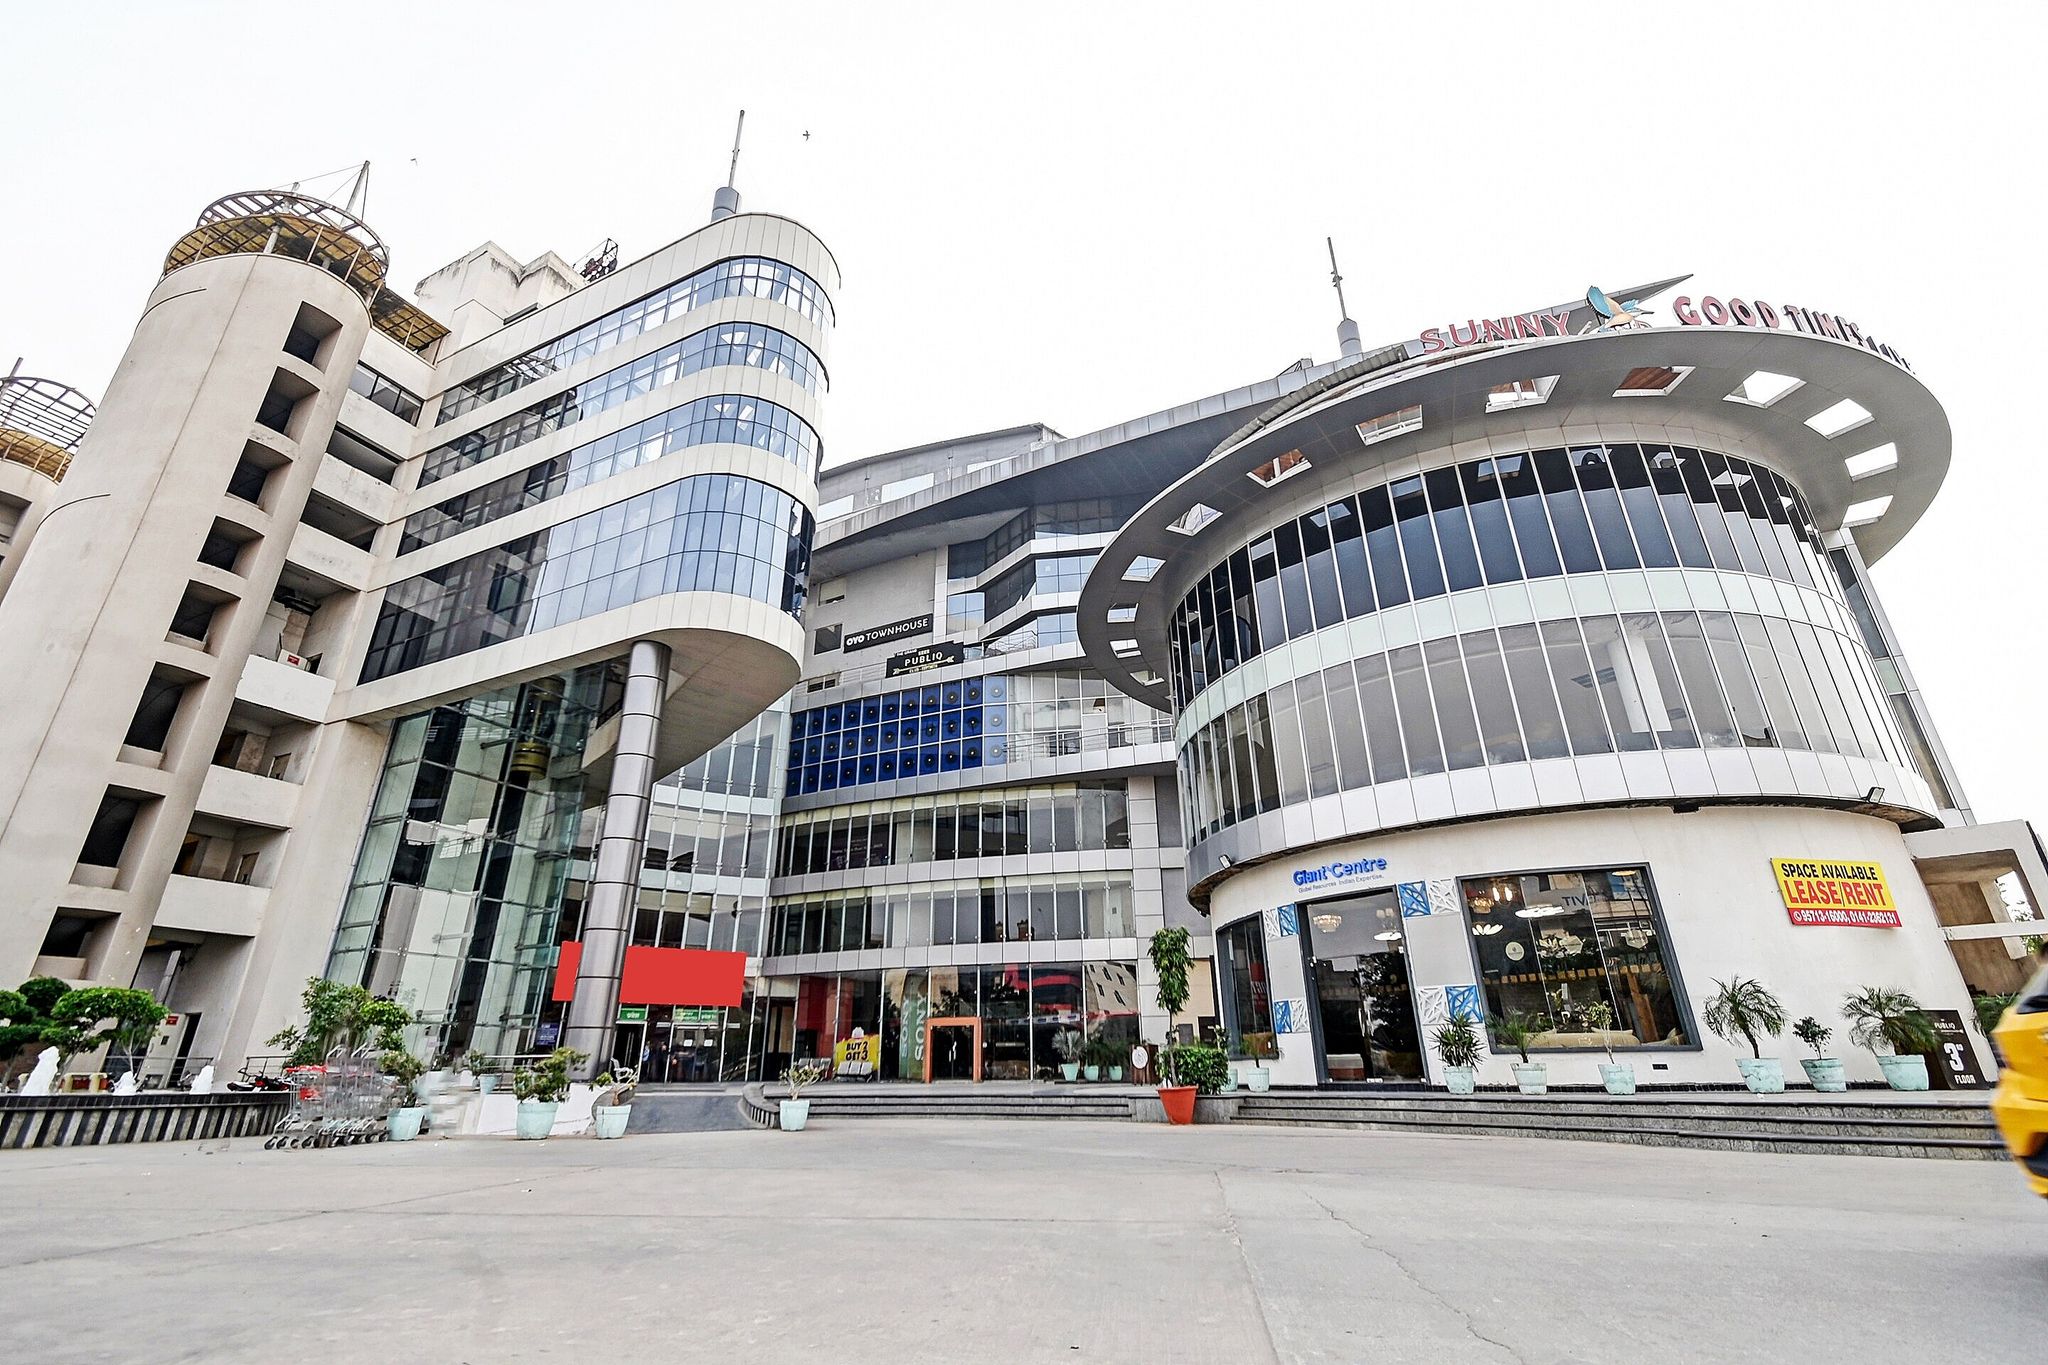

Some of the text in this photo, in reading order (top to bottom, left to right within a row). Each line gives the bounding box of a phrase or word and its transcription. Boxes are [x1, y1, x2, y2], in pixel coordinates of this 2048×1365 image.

[1420, 311, 1570, 354] SUNNY
[1673, 296, 1779, 328] GOOD
[846, 618, 928, 646] OYO TOWNHOUSE
[904, 651, 943, 667] PUBLIQ
[1293, 858, 1388, 886] Giant Centre
[1781, 863, 1878, 880] SPACE AVAILABLE
[1784, 880, 1886, 907] LEASE/RENT
[915, 993, 927, 1061] SONY
[846, 1040, 868, 1051] BUY 2
[861, 1050, 868, 1060] 3
[1954, 1074, 1976, 1084] FLOOR
